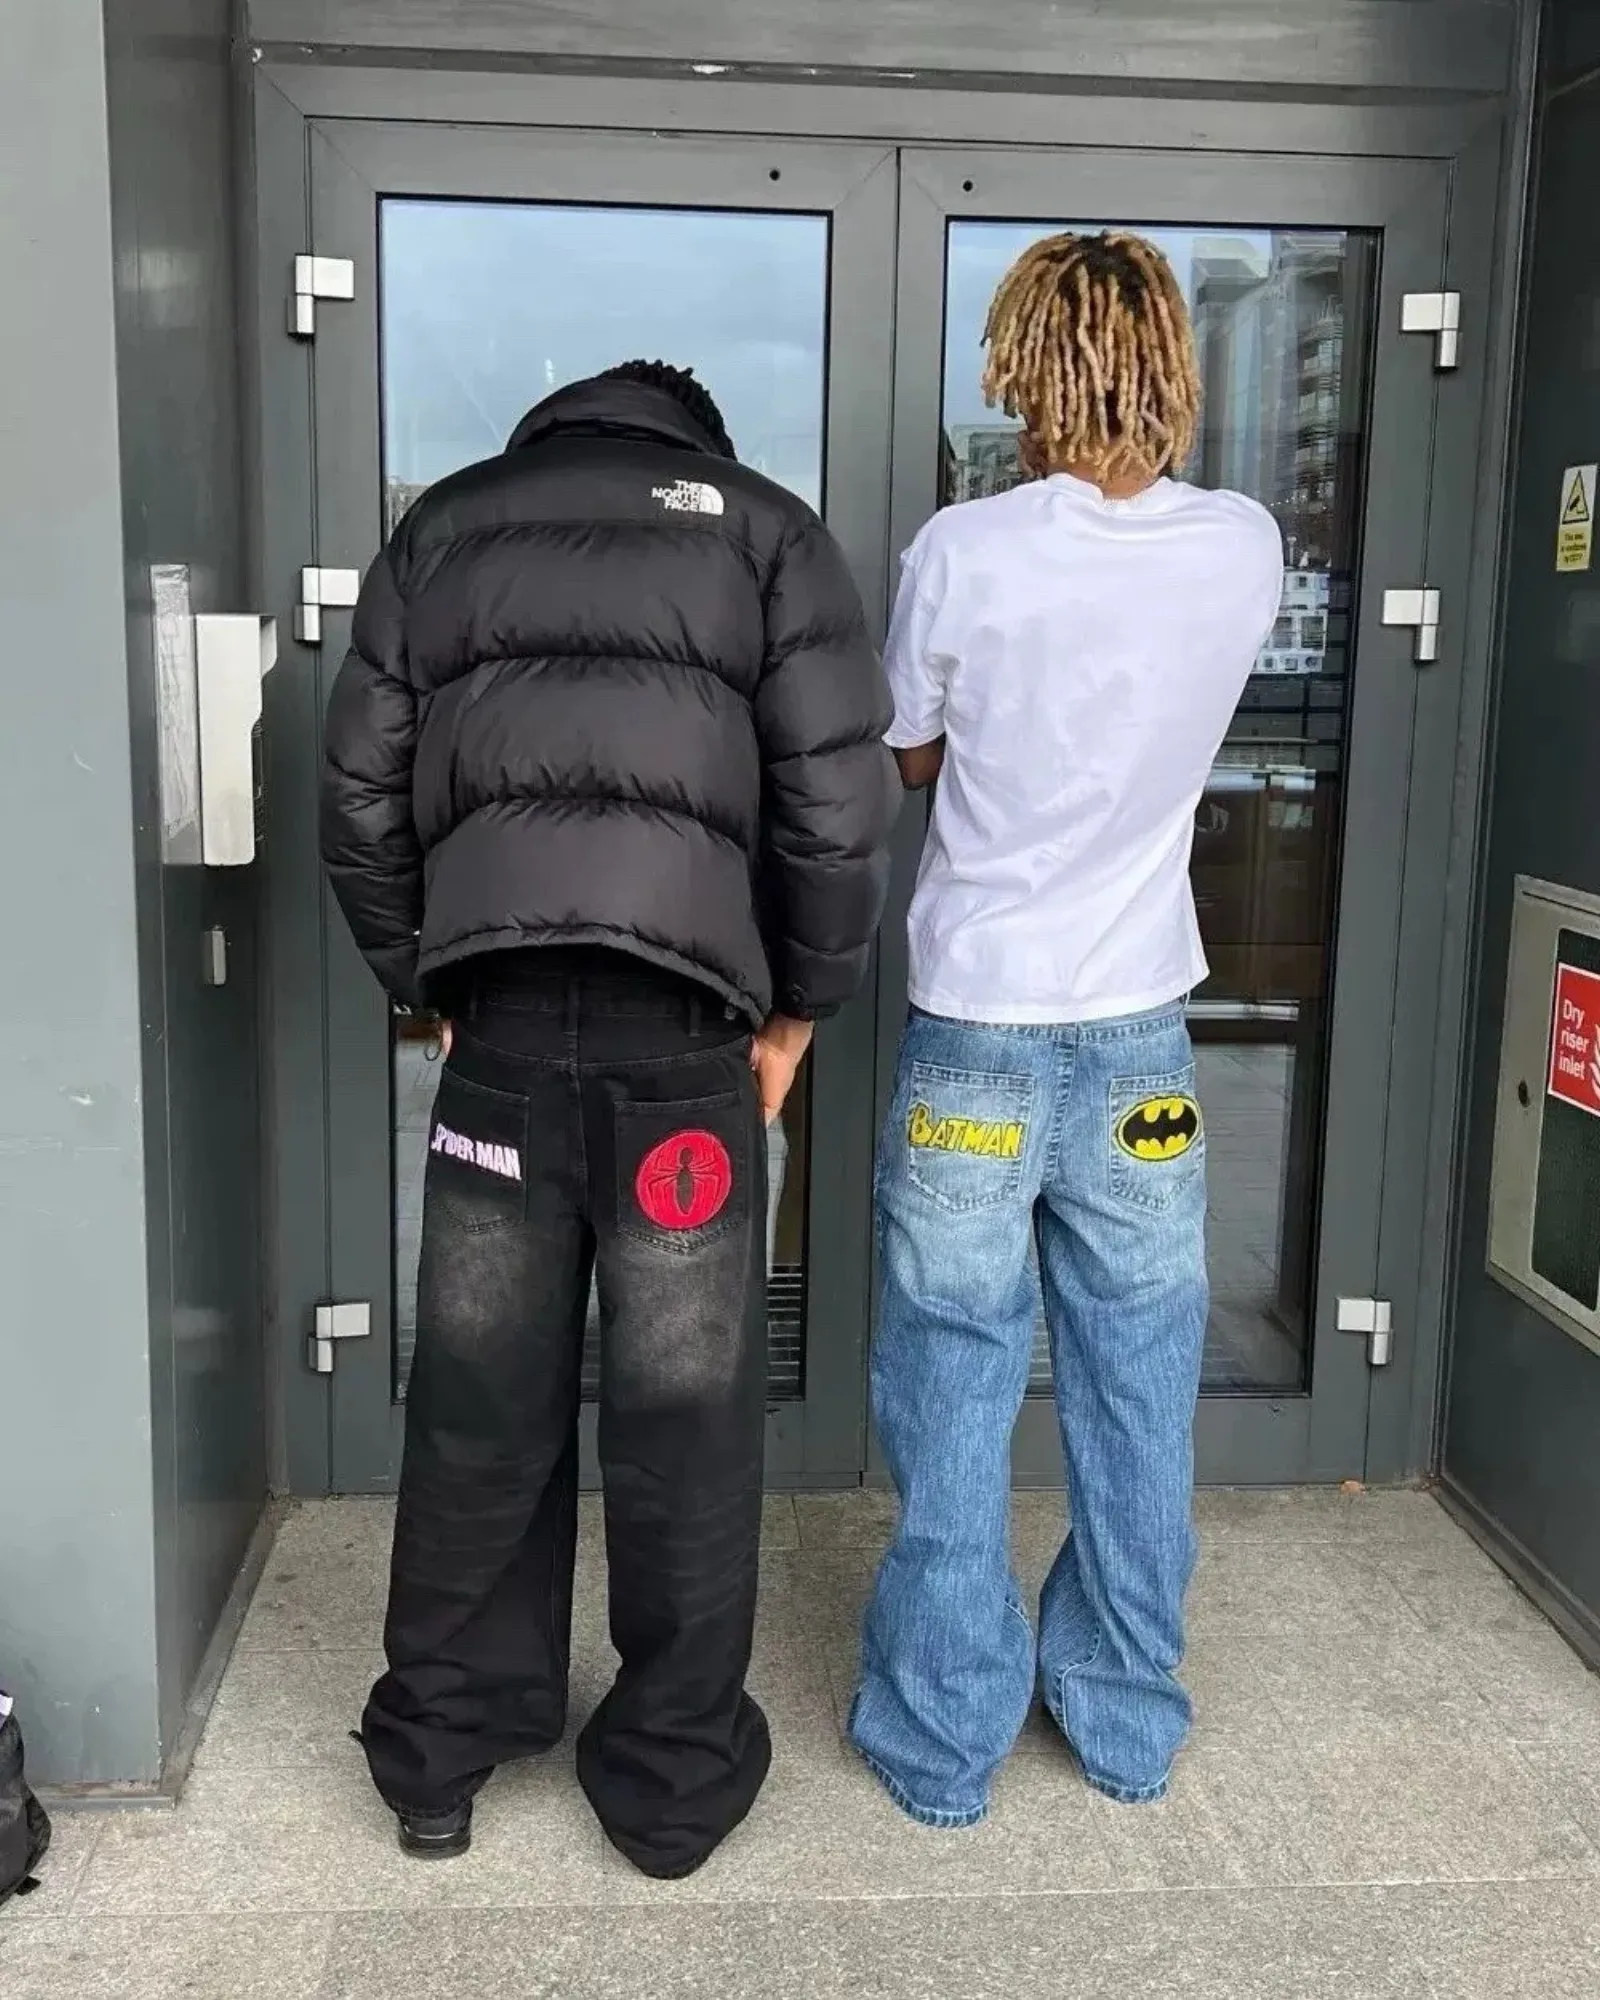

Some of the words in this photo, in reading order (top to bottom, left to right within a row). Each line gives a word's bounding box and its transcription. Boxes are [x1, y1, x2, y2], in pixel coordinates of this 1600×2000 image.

[652, 487, 700, 503] NORTH
[674, 479, 702, 493] THE
[665, 498, 699, 513] FACE
[1563, 998, 1585, 1031] Dry
[1561, 1026, 1590, 1054] riser
[1559, 1050, 1586, 1081] inlet
[908, 1102, 1024, 1158] BATMAN
[475, 1140, 522, 1181] MAN
